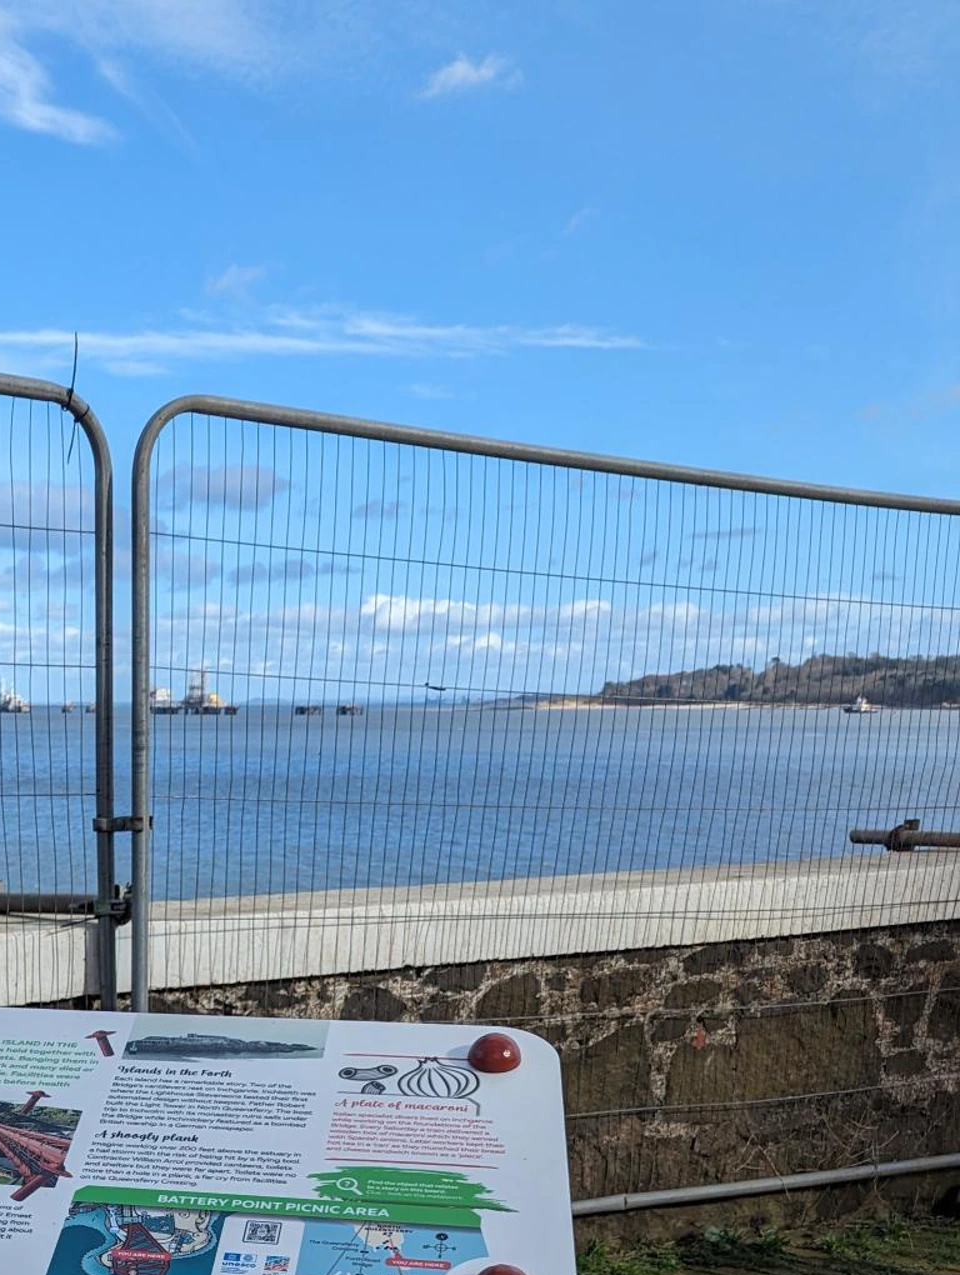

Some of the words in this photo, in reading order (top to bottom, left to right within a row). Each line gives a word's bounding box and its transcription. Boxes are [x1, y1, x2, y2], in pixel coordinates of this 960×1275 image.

[117, 1065, 162, 1075] Islands
[180, 1068, 198, 1076] the
[201, 1069, 232, 1078] Forth
[335, 1099, 348, 1107] A
[351, 1100, 384, 1108] plate
[388, 1101, 402, 1110] of
[404, 1103, 468, 1112] macaroni
[95, 1130, 107, 1138] A
[111, 1131, 160, 1142] shoogly
[161, 1133, 199, 1142] plank
[158, 1194, 229, 1207] BATTERY
[231, 1199, 283, 1211] POINT
[285, 1203, 341, 1214] PICNIC
[343, 1206, 390, 1217] AREA
